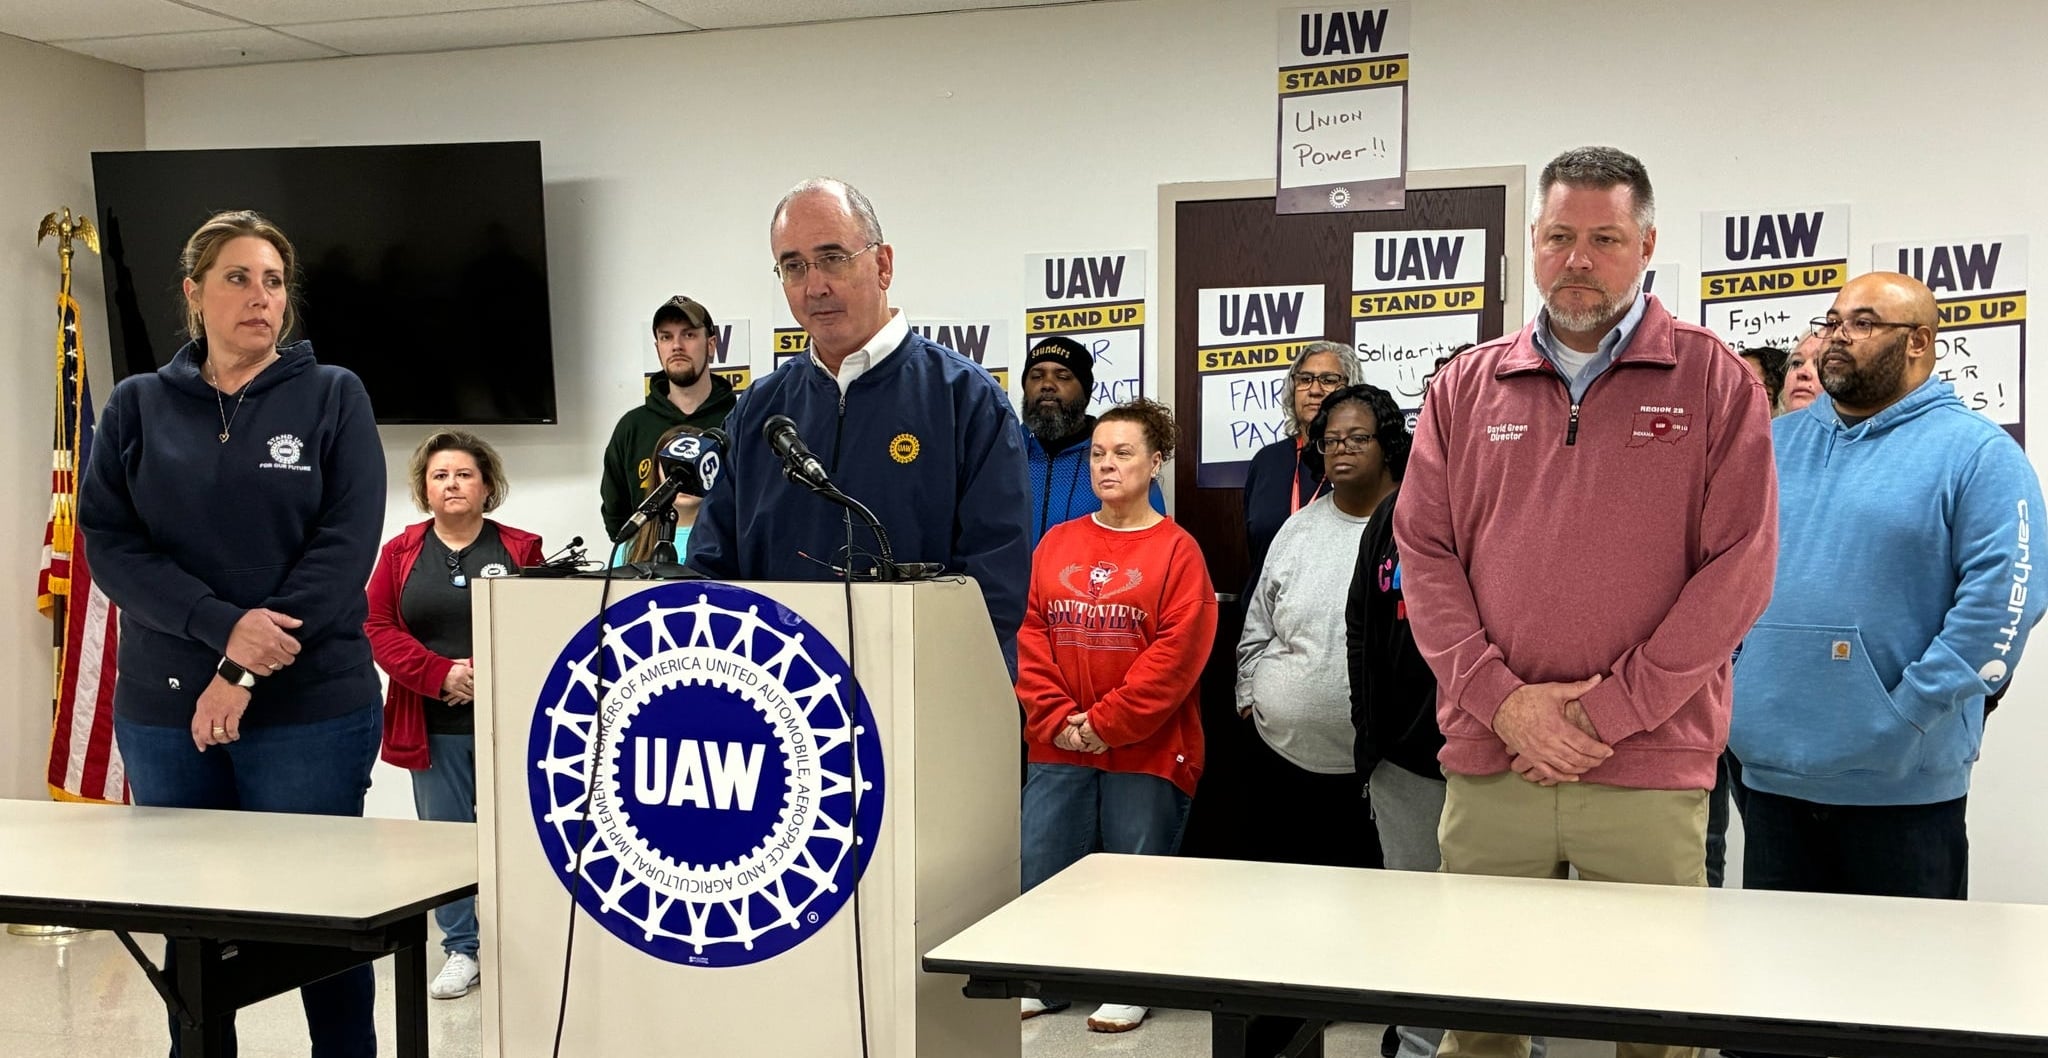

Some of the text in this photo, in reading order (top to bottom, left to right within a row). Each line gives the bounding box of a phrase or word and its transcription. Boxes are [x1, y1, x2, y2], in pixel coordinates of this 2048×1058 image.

[1300, 9, 1389, 56] UAW
[1286, 63, 1400, 90] STAND UP
[1725, 211, 1824, 261] UAW
[1375, 236, 1464, 281] UAW
[1045, 256, 1126, 299] UAW
[1709, 269, 1837, 295] STAND UP
[1219, 292, 1304, 336] UAW
[1359, 291, 1475, 314] STAND UP
[1980, 301, 2017, 319] UP
[1032, 308, 1137, 330] STAND UP
[1730, 310, 1790, 334] Fight
[1205, 350, 1279, 368] STAND
[1230, 379, 1286, 411] FAIR
[267, 434, 304, 447] STAND UP
[1230, 420, 1284, 449] PAY
[1487, 423, 1528, 434] David Green
[1490, 432, 1523, 441] Director
[674, 440, 696, 453] 5
[703, 456, 717, 475] 5
[1993, 499, 2032, 656] carhartt
[1048, 600, 1149, 630] SOUTHVIEW
[640, 657, 701, 686] AMERICA
[706, 658, 758, 686] UNITED
[620, 679, 637, 700] OF
[757, 684, 811, 779] AUTOMOBILE,
[635, 736, 766, 811] UAW
[766, 784, 810, 867] AEROSPACE
[632, 852, 733, 893] AGRICULTURAL
[737, 861, 766, 886] AND
